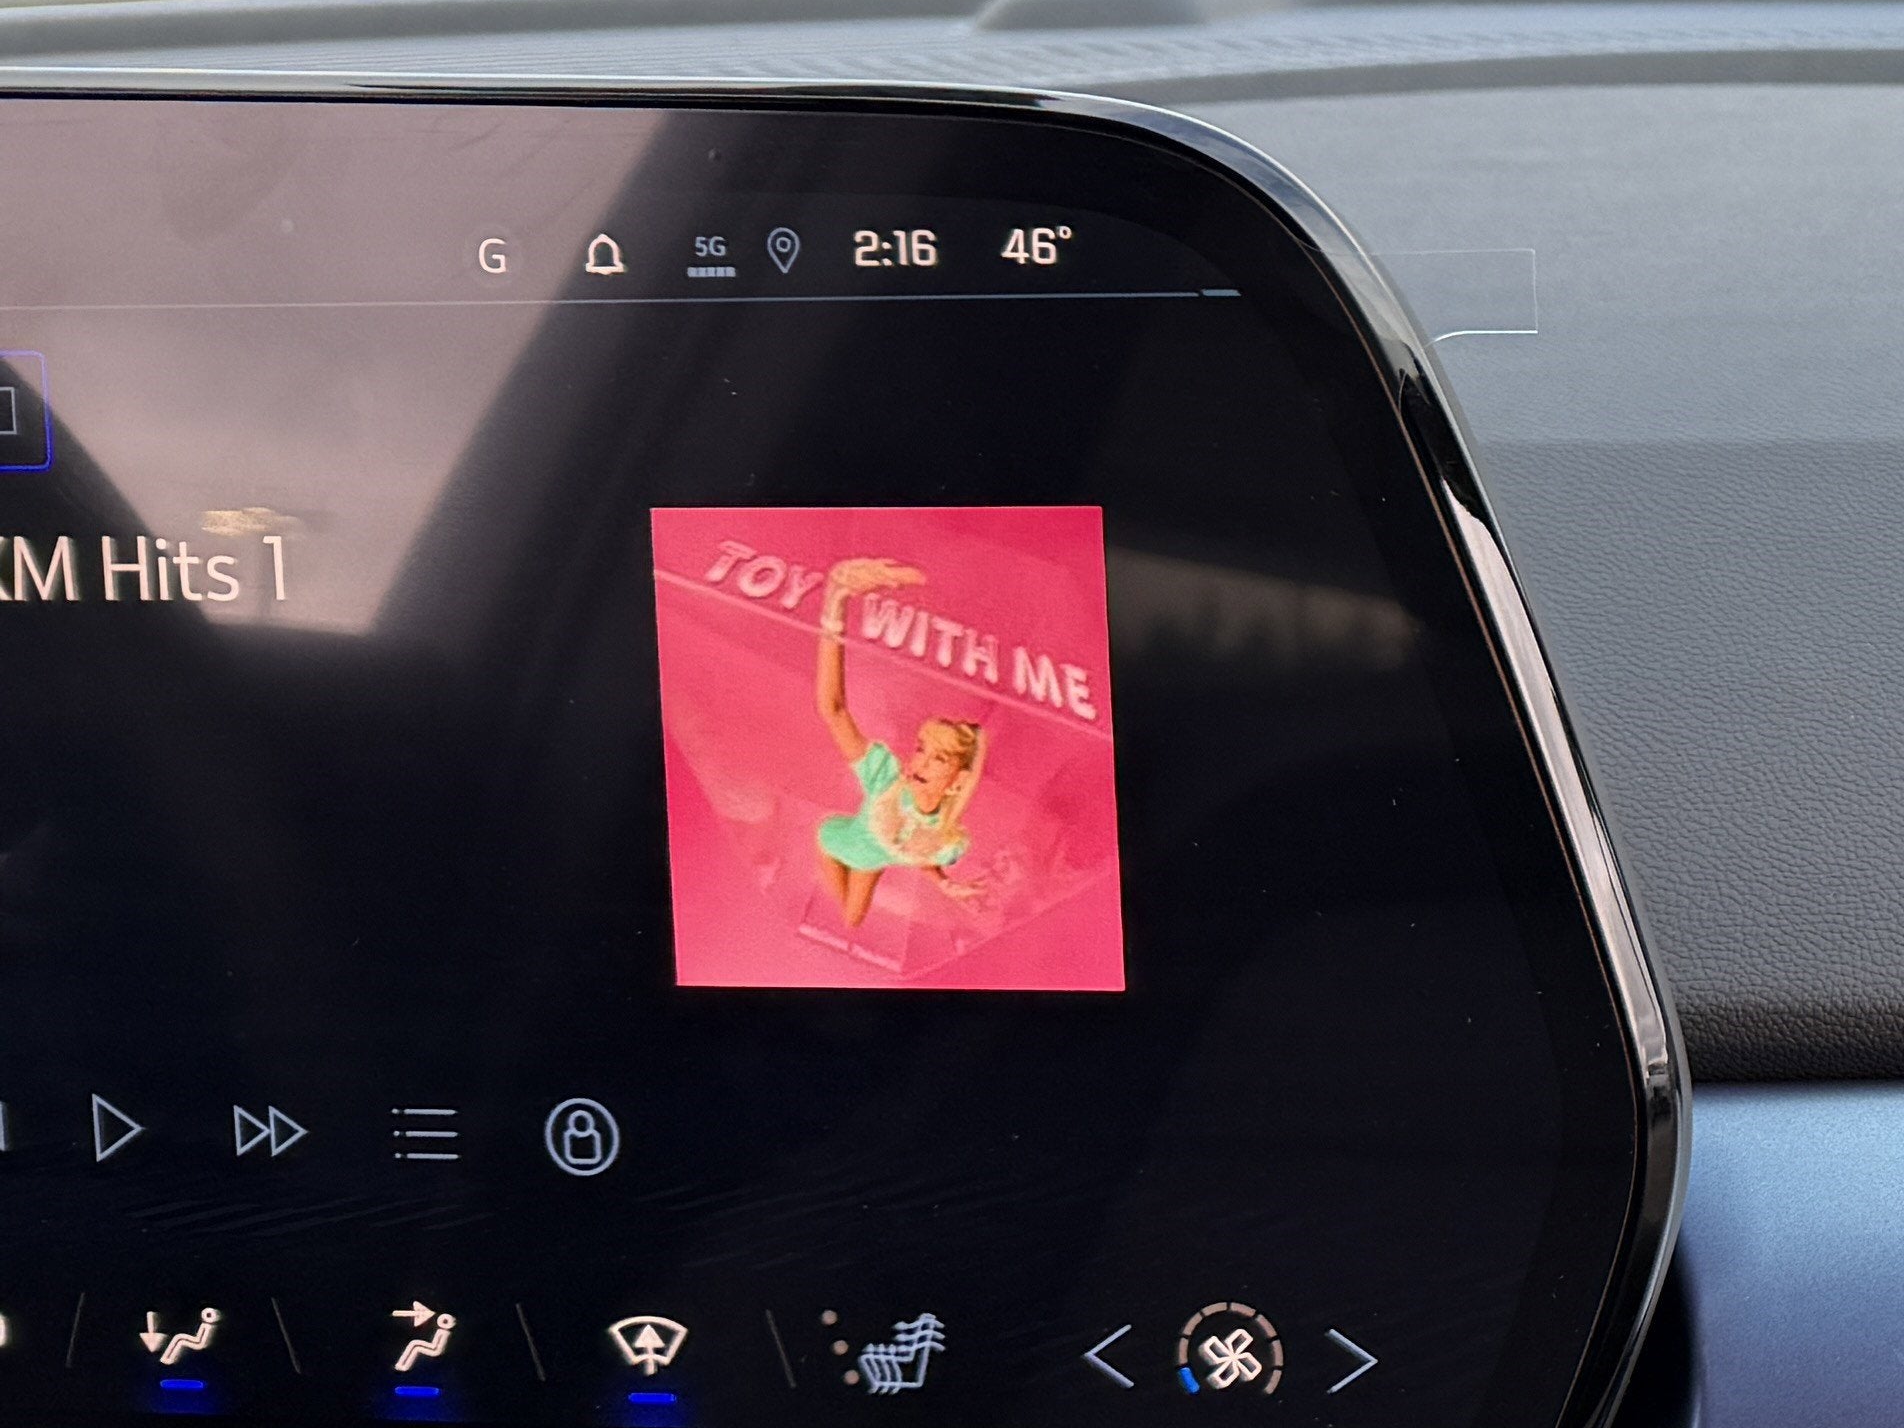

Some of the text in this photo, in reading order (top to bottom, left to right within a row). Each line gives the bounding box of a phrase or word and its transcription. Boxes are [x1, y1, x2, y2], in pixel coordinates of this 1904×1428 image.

[478, 239, 508, 274] G
[694, 236, 726, 257] 5G
[854, 229, 938, 268] 2:16
[1002, 225, 1074, 267] 46°
[0, 535, 287, 602] M Hits 1
[704, 541, 1099, 720] TOY WITH ME
